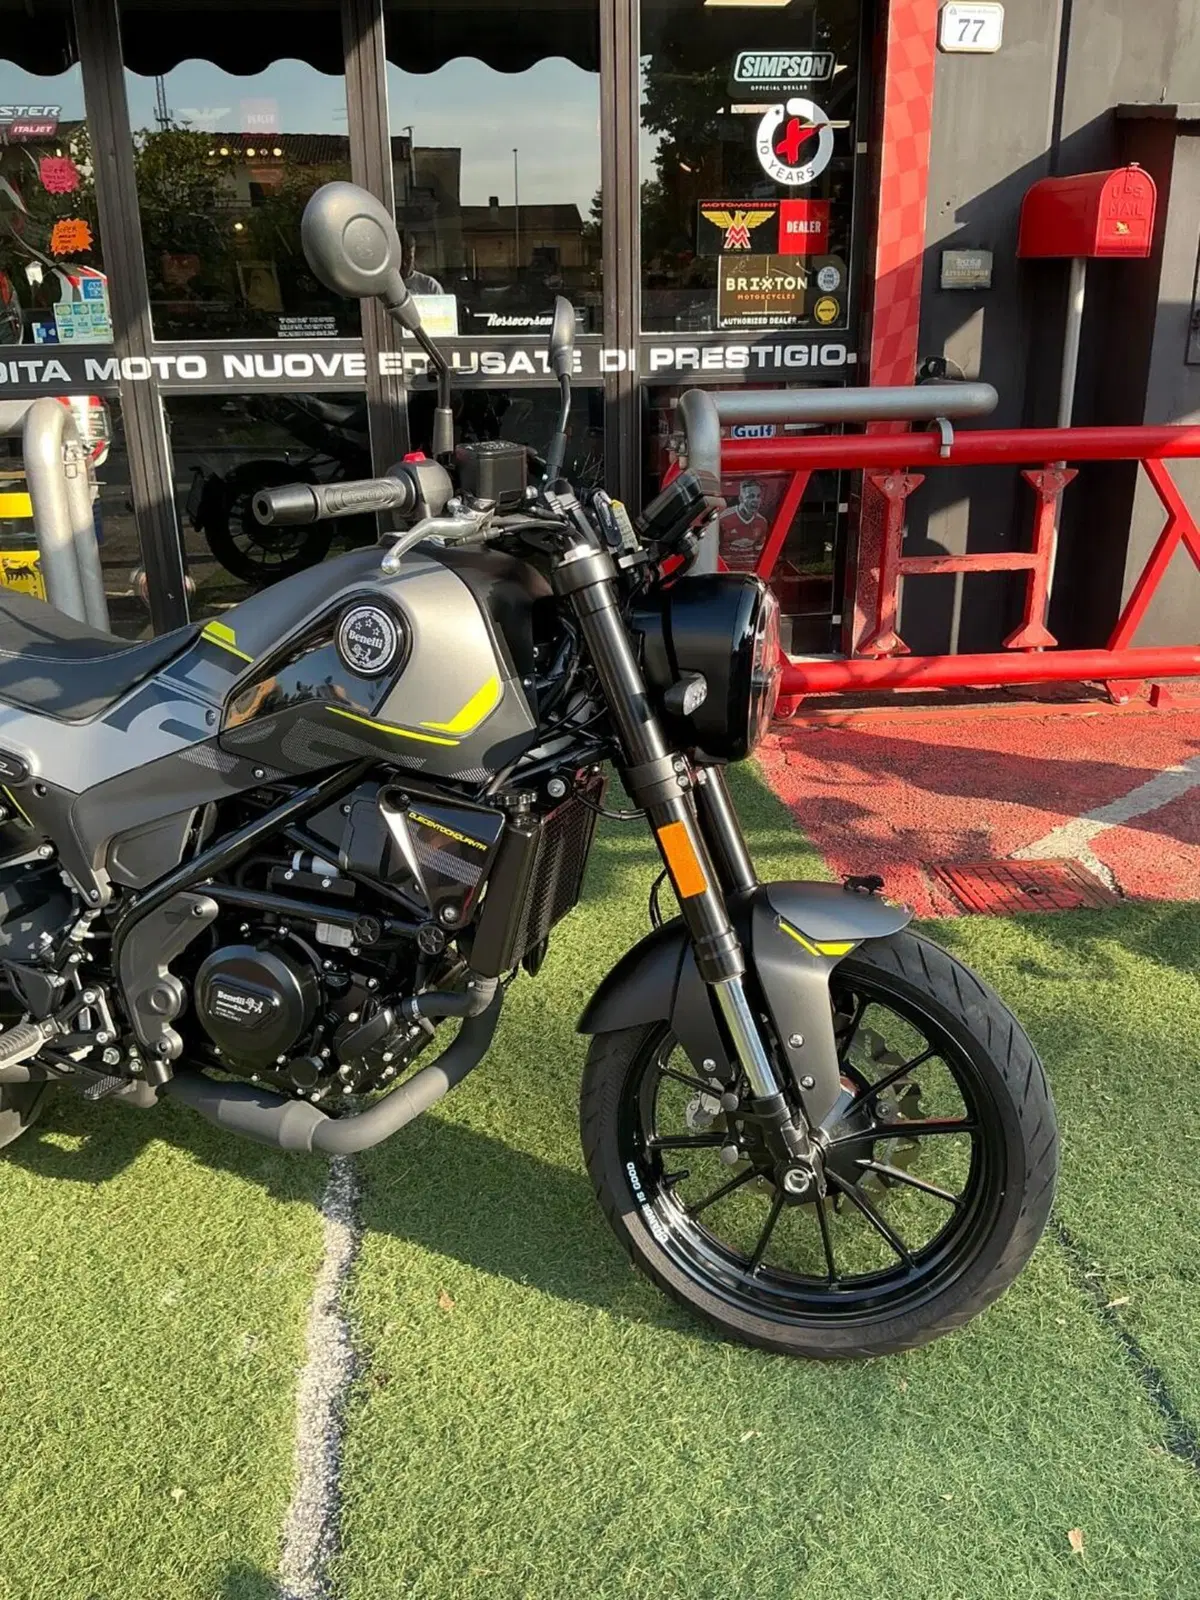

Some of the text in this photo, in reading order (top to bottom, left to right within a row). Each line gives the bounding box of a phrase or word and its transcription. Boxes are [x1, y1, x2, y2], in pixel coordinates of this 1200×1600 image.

[958, 18, 986, 43] 77
[741, 56, 827, 77] SIMPSON
[750, 84, 781, 92] OFFICIAL
[13, 125, 53, 133] ITALJET
[767, 158, 816, 183] YEARS
[1108, 199, 1145, 217] MAIL
[786, 220, 821, 234] DEALER
[725, 277, 808, 292] BRIXTON
[737, 293, 796, 301] MOTORCYCLES
[723, 316, 798, 326] AUTHORIZED DEALER
[84, 355, 207, 381] MOTO
[222, 353, 367, 378] NUOVE
[600, 349, 636, 372] DI
[734, 424, 773, 438] Gulf
[348, 629, 383, 649] Benelli
[626, 1161, 669, 1243] CHANGE IS GOOD
